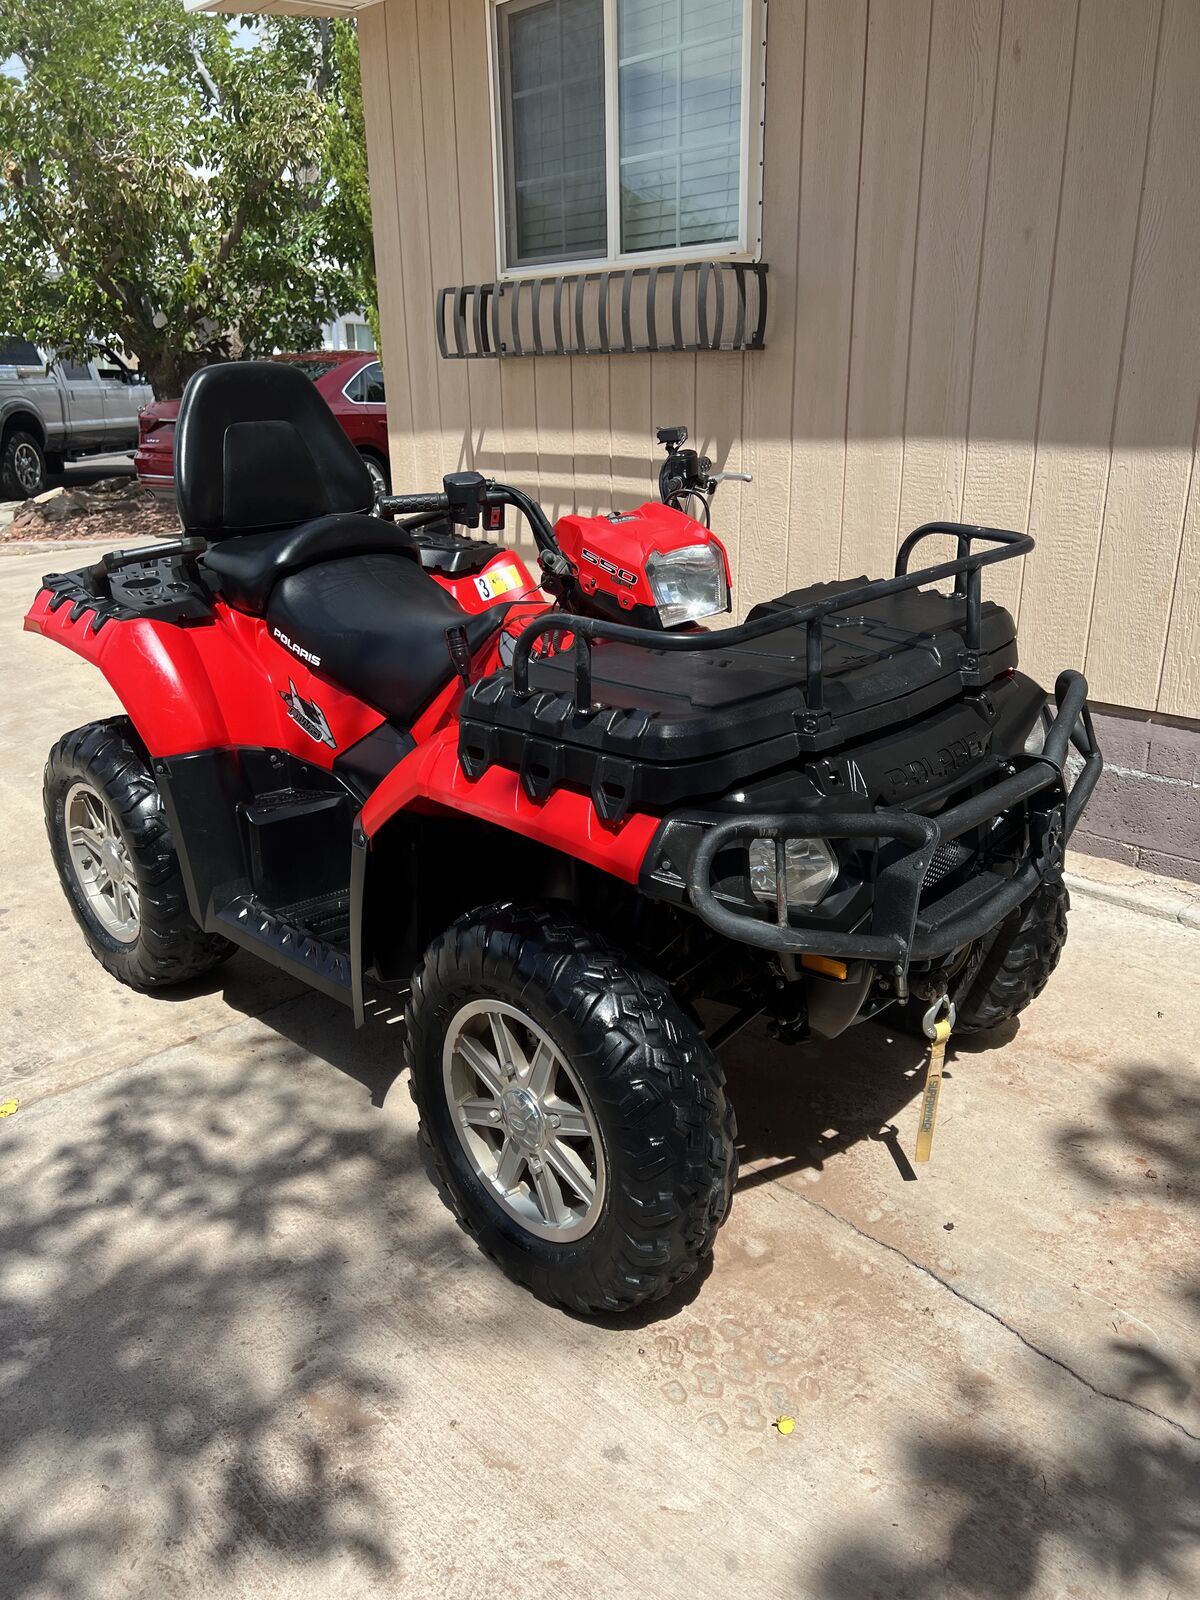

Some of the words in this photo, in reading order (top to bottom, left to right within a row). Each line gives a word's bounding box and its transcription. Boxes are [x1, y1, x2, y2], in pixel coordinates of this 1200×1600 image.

[581, 547, 638, 585] 550
[478, 578, 490, 598] 3
[273, 627, 321, 667] POLARIS
[883, 731, 984, 796] POLARIS
